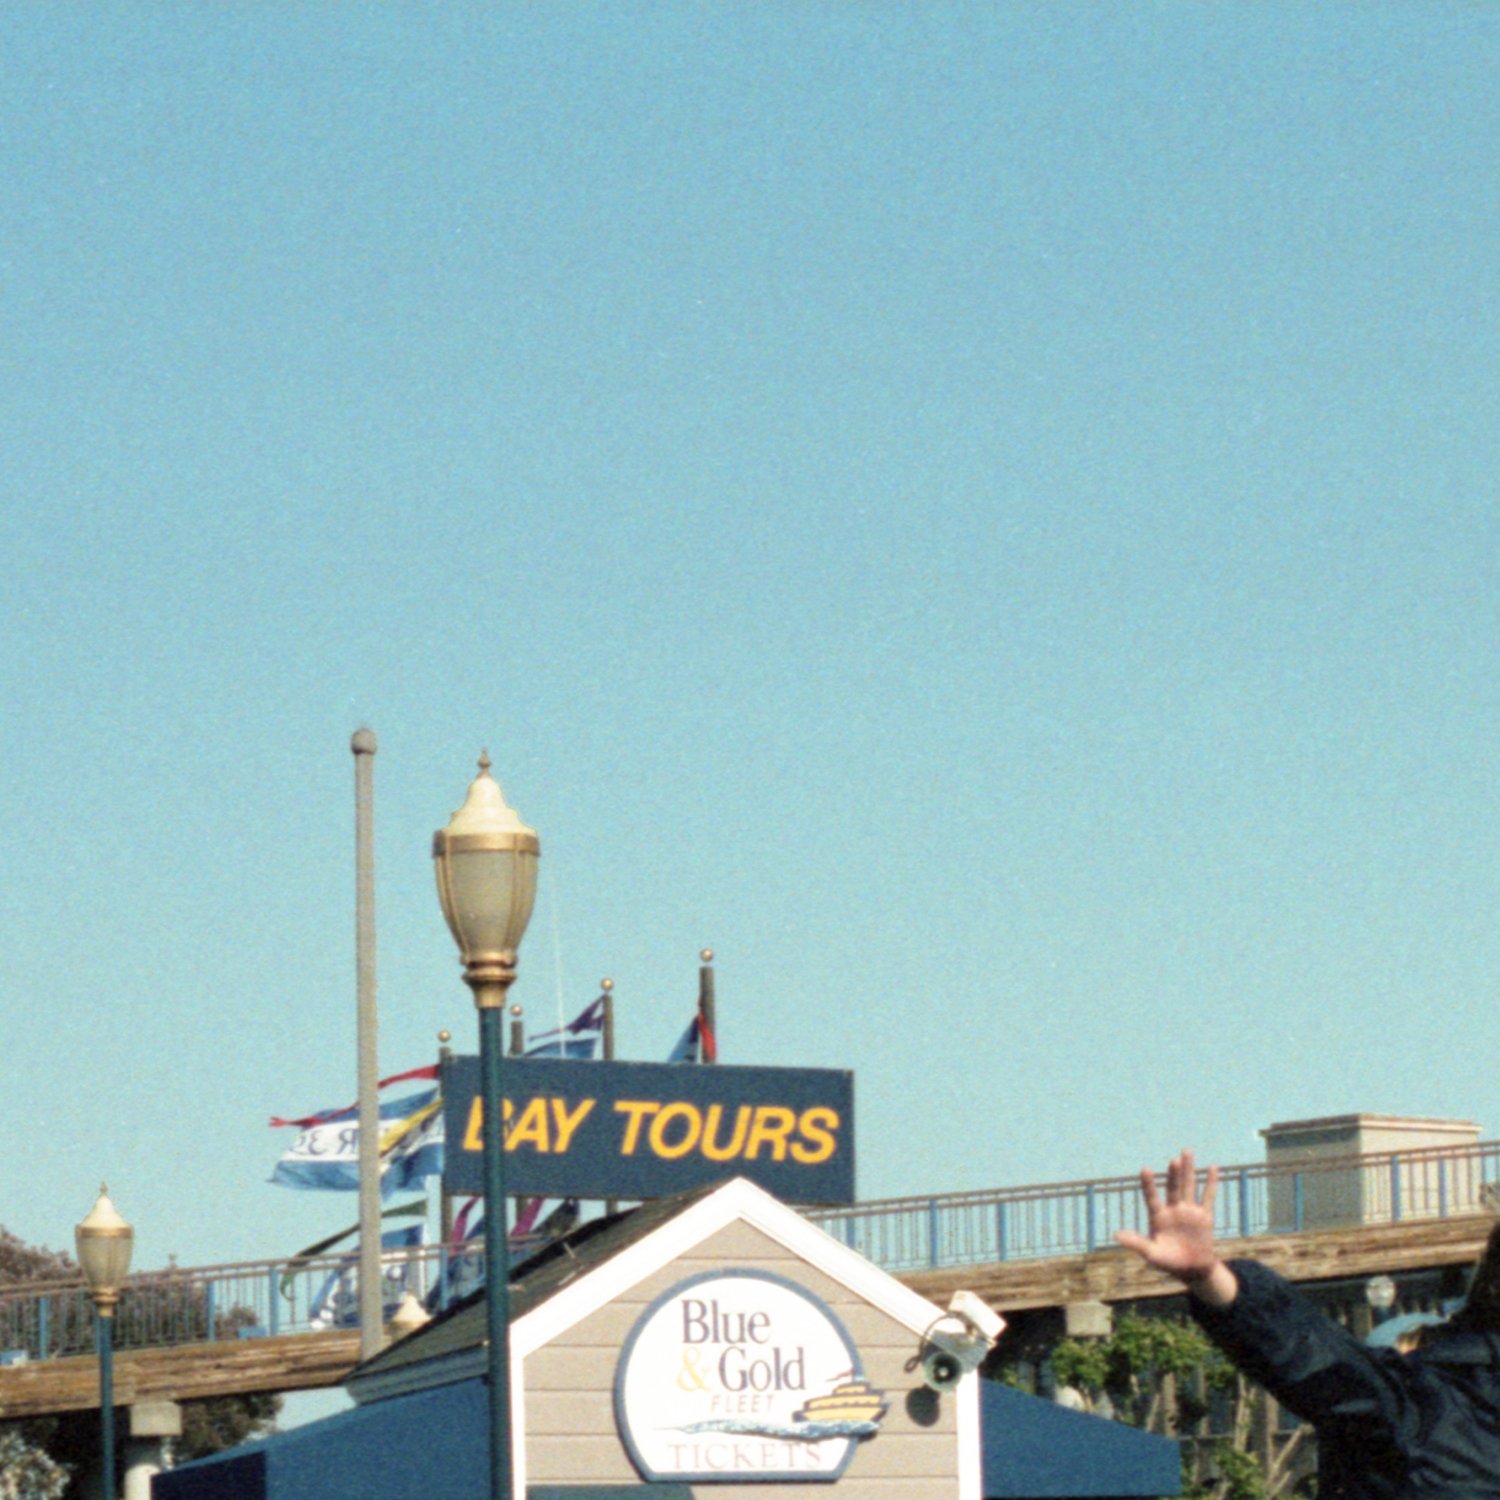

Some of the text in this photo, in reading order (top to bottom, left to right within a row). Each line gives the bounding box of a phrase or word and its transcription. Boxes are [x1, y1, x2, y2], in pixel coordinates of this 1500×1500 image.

[613, 1100, 840, 1164] TOURS
[681, 1299, 771, 1345] Blue
[675, 1345, 806, 1392] & Gold
[709, 1394, 775, 1413] FLEET
[666, 1437, 822, 1470] TICKETS
